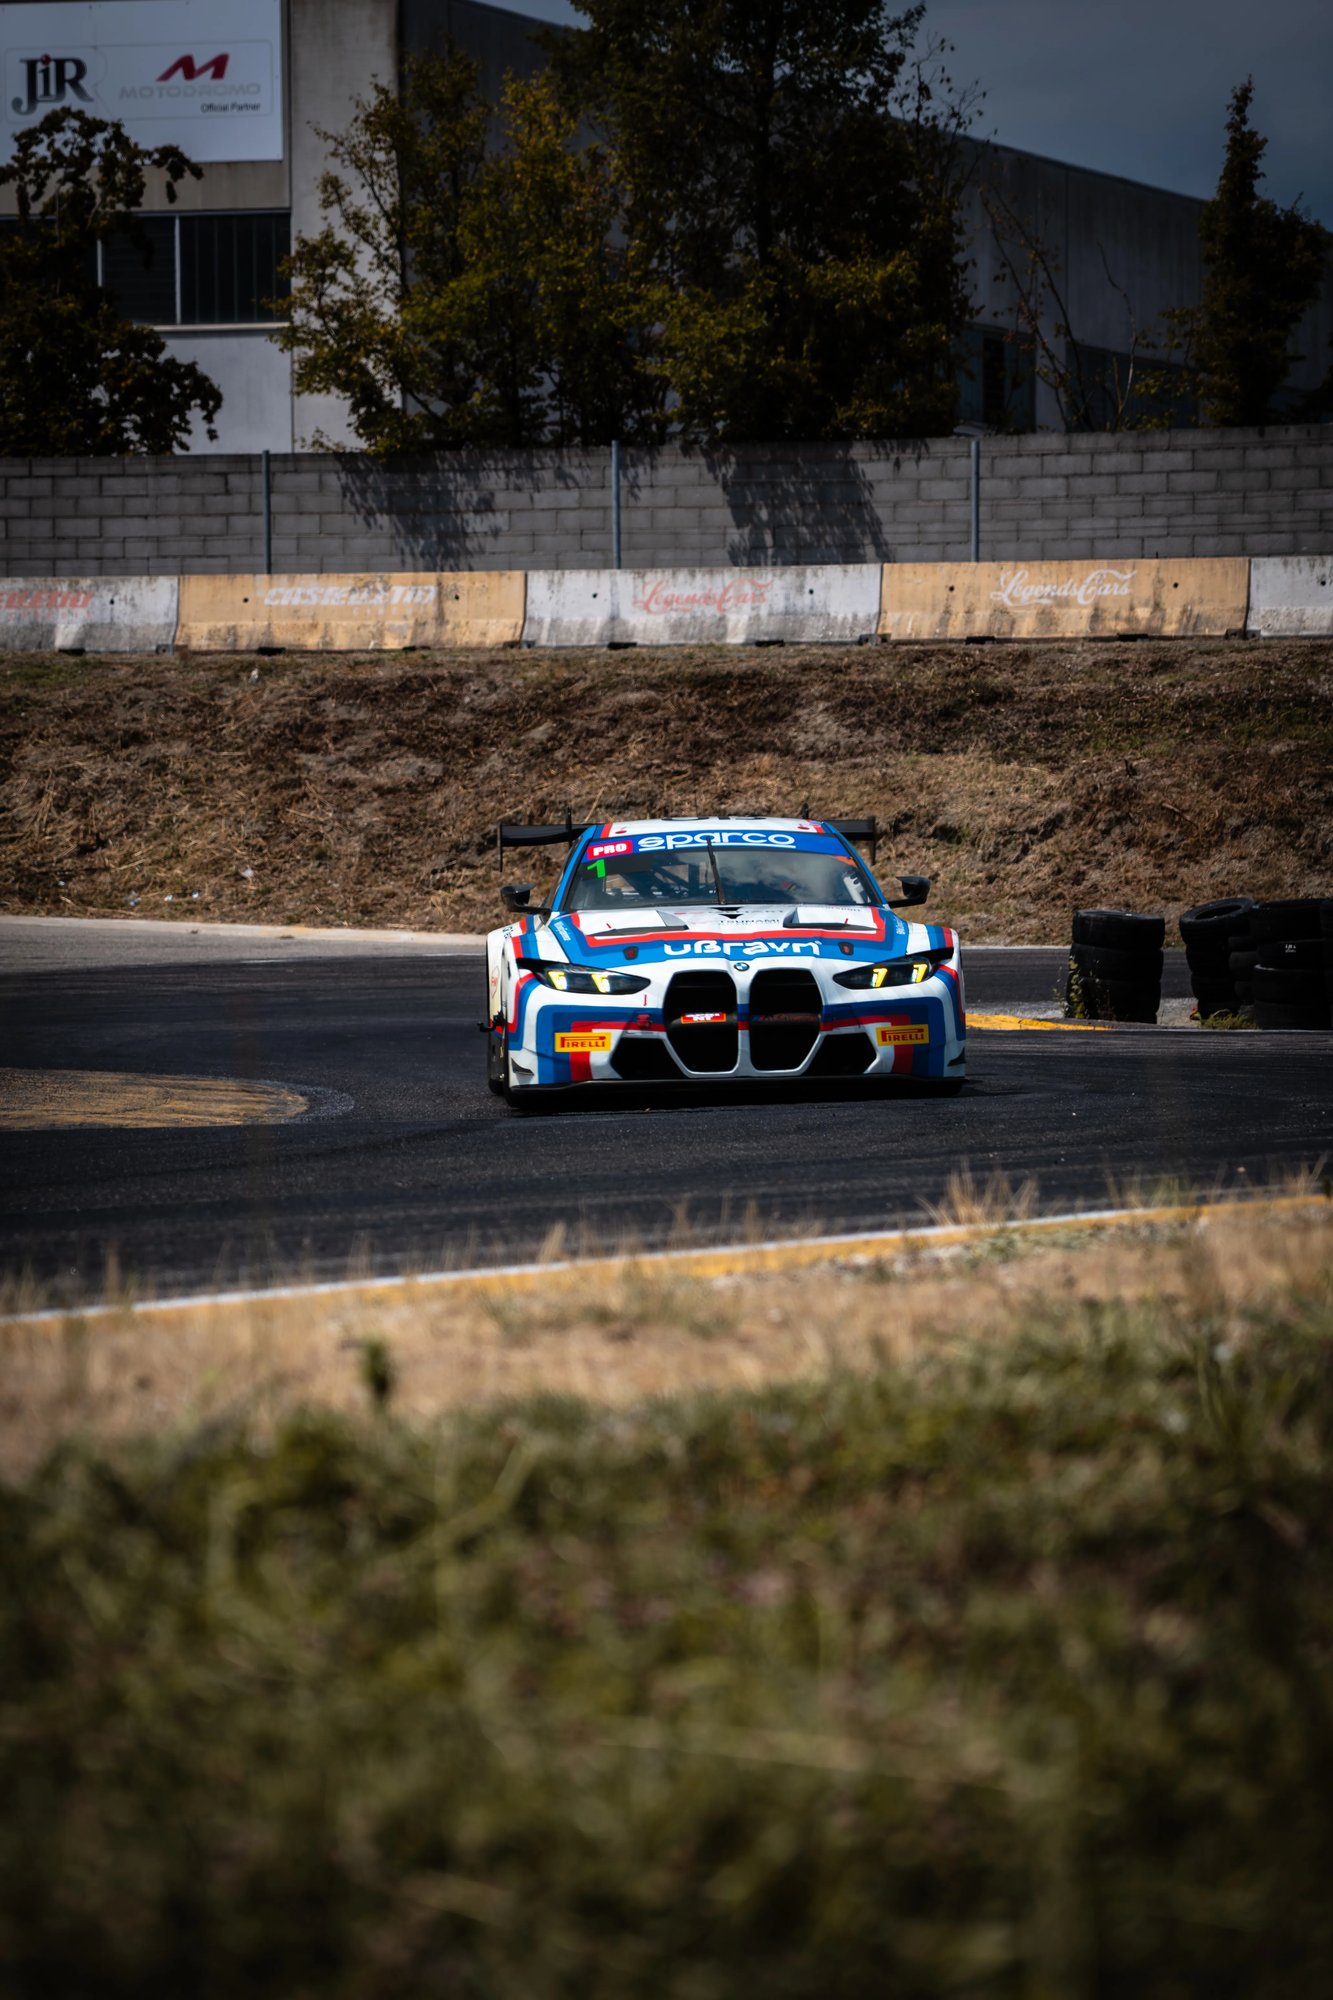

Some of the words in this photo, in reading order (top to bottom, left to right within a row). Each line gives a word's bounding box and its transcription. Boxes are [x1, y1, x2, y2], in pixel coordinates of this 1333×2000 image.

[119, 82, 261, 100] MOTODROMO
[201, 103, 229, 113] Official
[231, 102, 261, 112] Partner
[593, 842, 628, 857] PRO
[638, 832, 797, 850] sparco
[587, 859, 606, 878] 1
[560, 1036, 606, 1048] PIRELLI
[881, 1028, 925, 1042] PIRELLI
